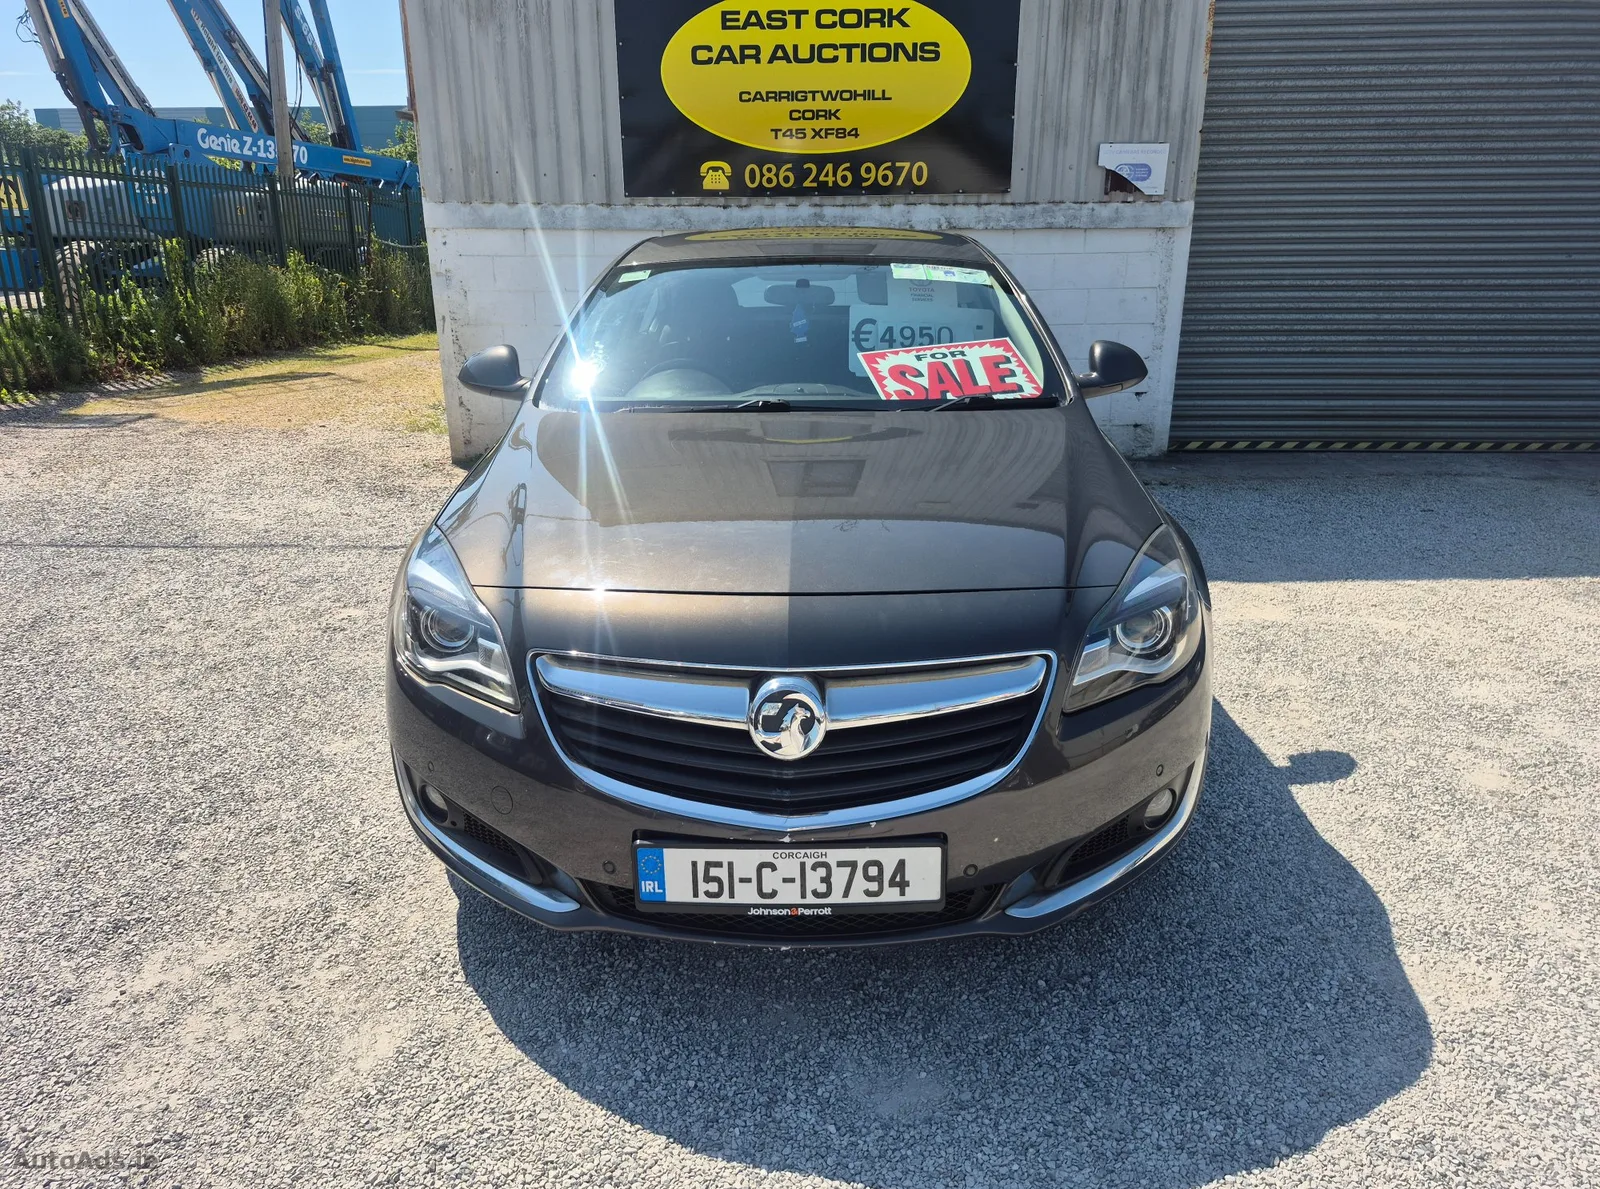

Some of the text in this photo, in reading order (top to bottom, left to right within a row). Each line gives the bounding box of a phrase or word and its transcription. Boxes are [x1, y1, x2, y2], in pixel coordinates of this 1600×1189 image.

[721, 8, 911, 30] EAST CORK
[691, 42, 941, 65] CAR AUCTIONS
[222, 64, 233, 83] Hire
[738, 90, 892, 102] CARRIGTWOHILL
[789, 109, 841, 121] CORK
[197, 128, 241, 154] Genie
[770, 127, 860, 140] T45 XF84
[744, 161, 928, 188] 086 246 9670
[914, 350, 967, 362] FOR
[888, 354, 1024, 400] SALE
[773, 851, 828, 859] CORCAIGH
[641, 858, 911, 899] IRL 151-C-13794
